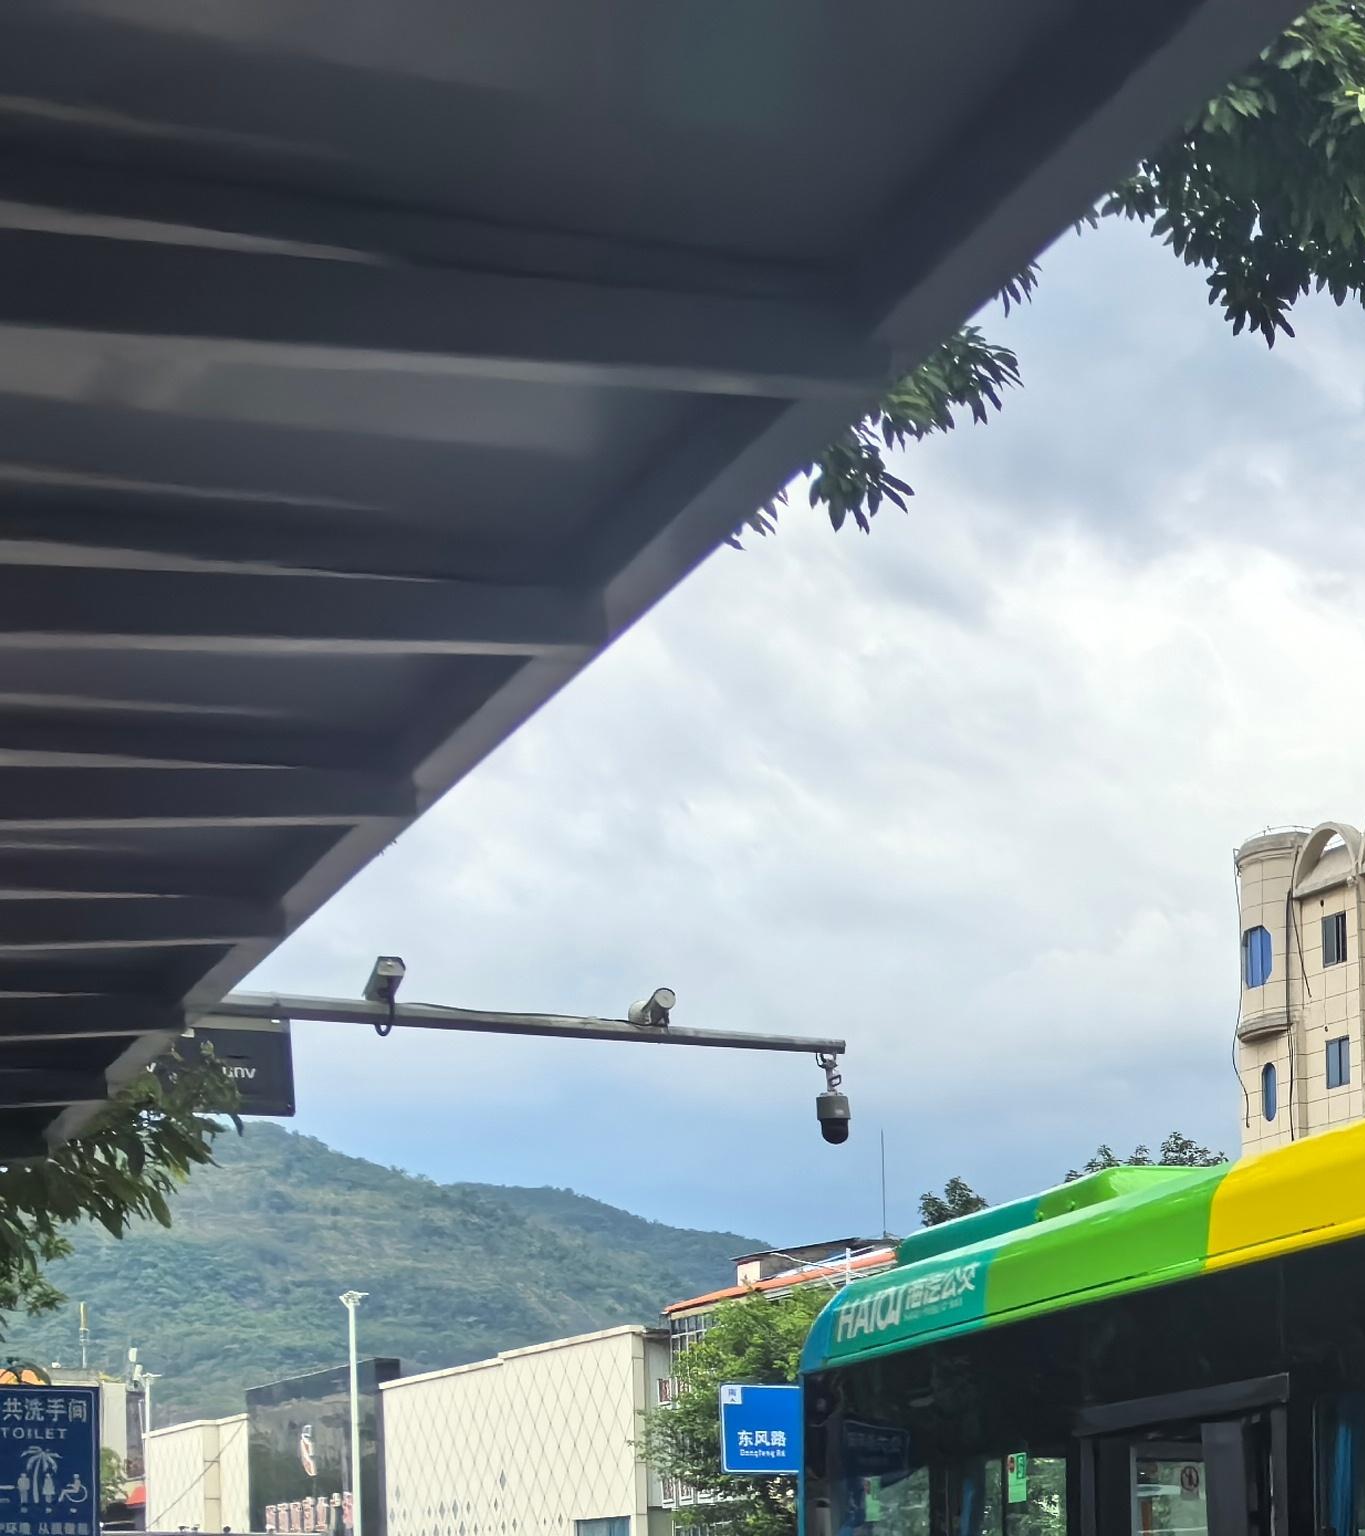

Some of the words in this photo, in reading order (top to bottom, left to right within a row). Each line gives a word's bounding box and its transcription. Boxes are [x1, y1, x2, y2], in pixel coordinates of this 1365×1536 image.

[0, 1427, 68, 1440] TOILET
[737, 1430, 786, 1447] 东风路
